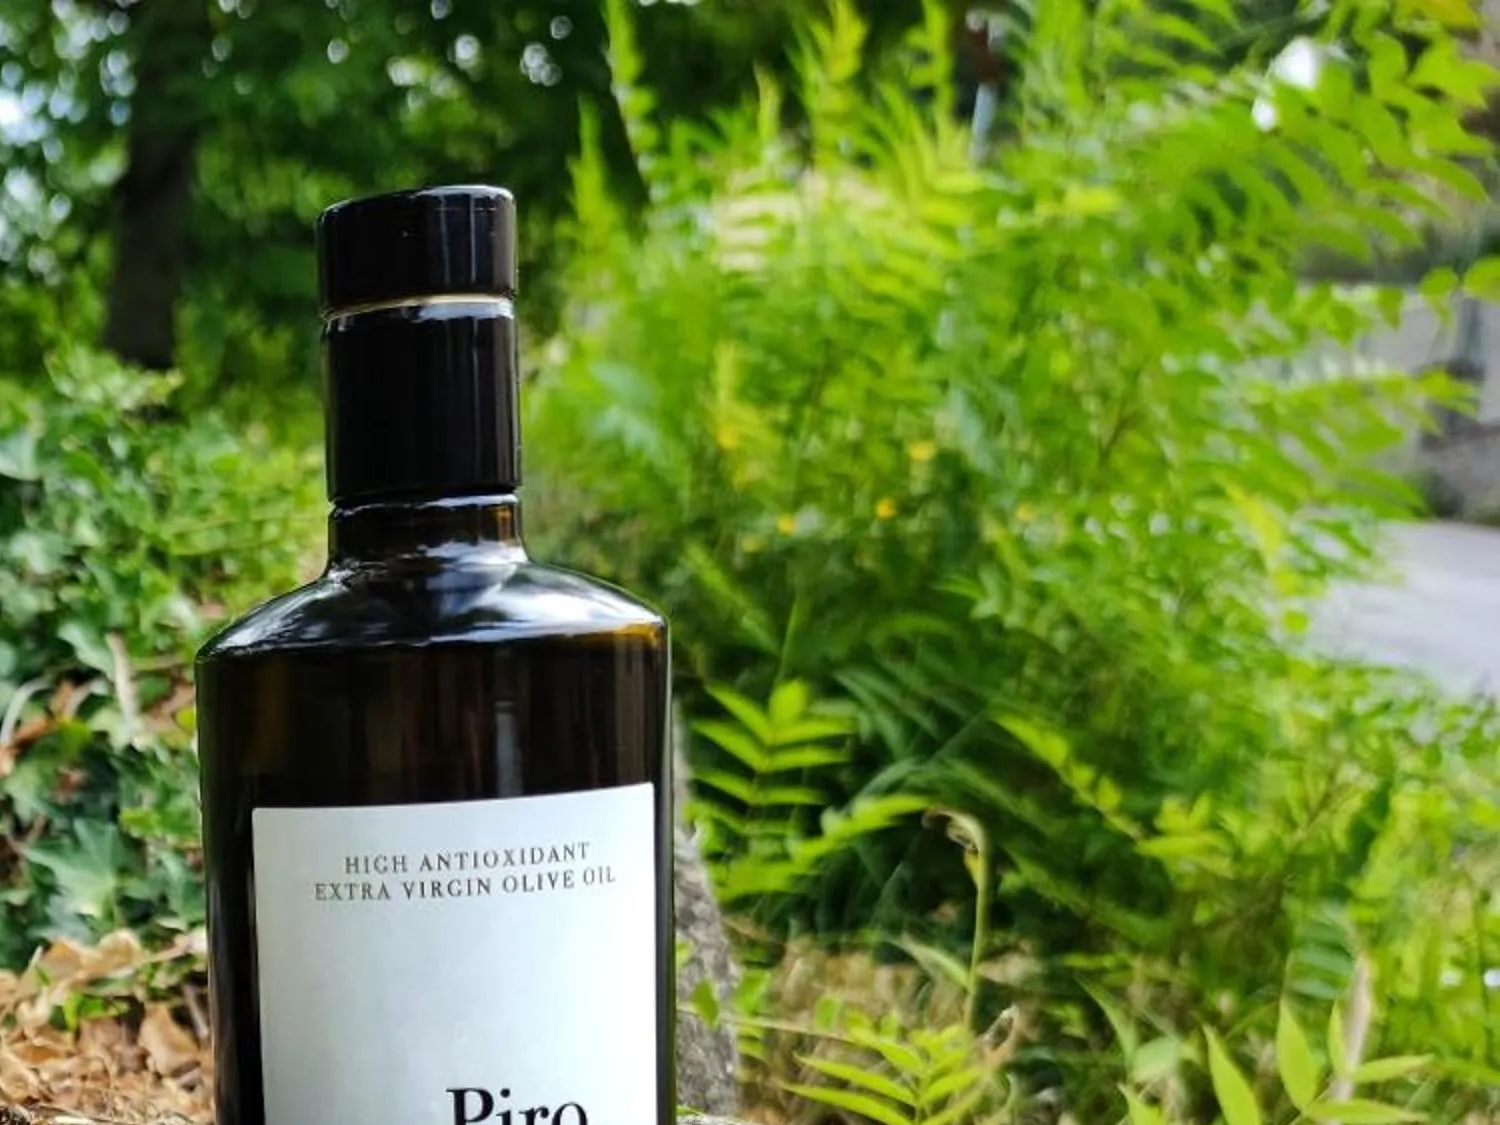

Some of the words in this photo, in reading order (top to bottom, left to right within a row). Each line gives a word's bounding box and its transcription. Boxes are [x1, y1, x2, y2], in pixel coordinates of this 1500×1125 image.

[345, 855, 408, 874] HIGH
[419, 842, 591, 872] ANTIOXIDANT
[315, 881, 392, 901] EXTRA
[403, 877, 491, 899] VIRGIN
[502, 868, 575, 893] OLIVE
[583, 866, 617, 885] OIL
